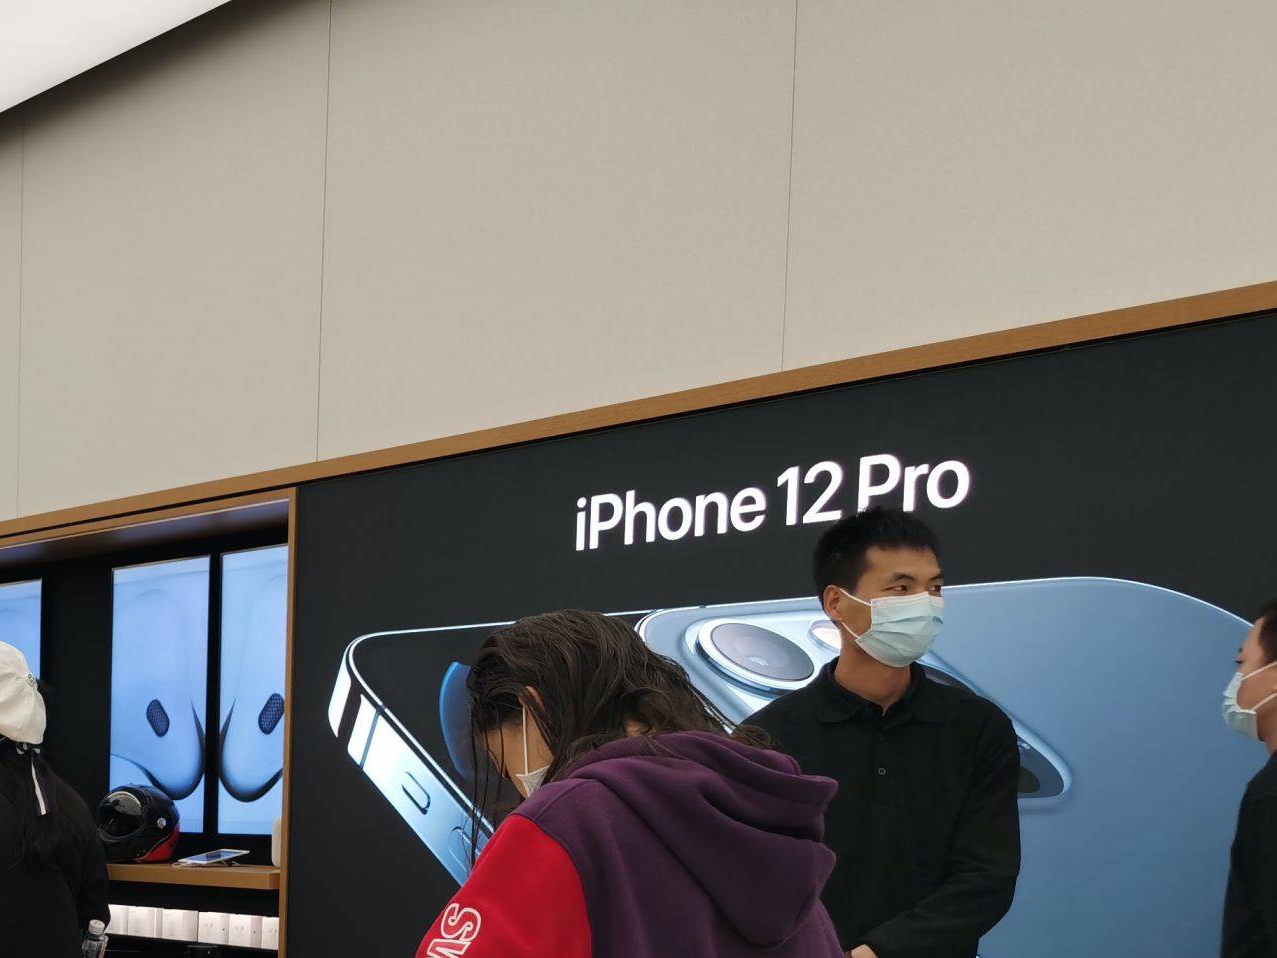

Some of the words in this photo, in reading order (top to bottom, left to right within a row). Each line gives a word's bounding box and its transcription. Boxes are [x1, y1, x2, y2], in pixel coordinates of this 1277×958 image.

[575, 486, 767, 552] iPhone
[776, 460, 844, 526] 12
[857, 453, 971, 513] Pro
